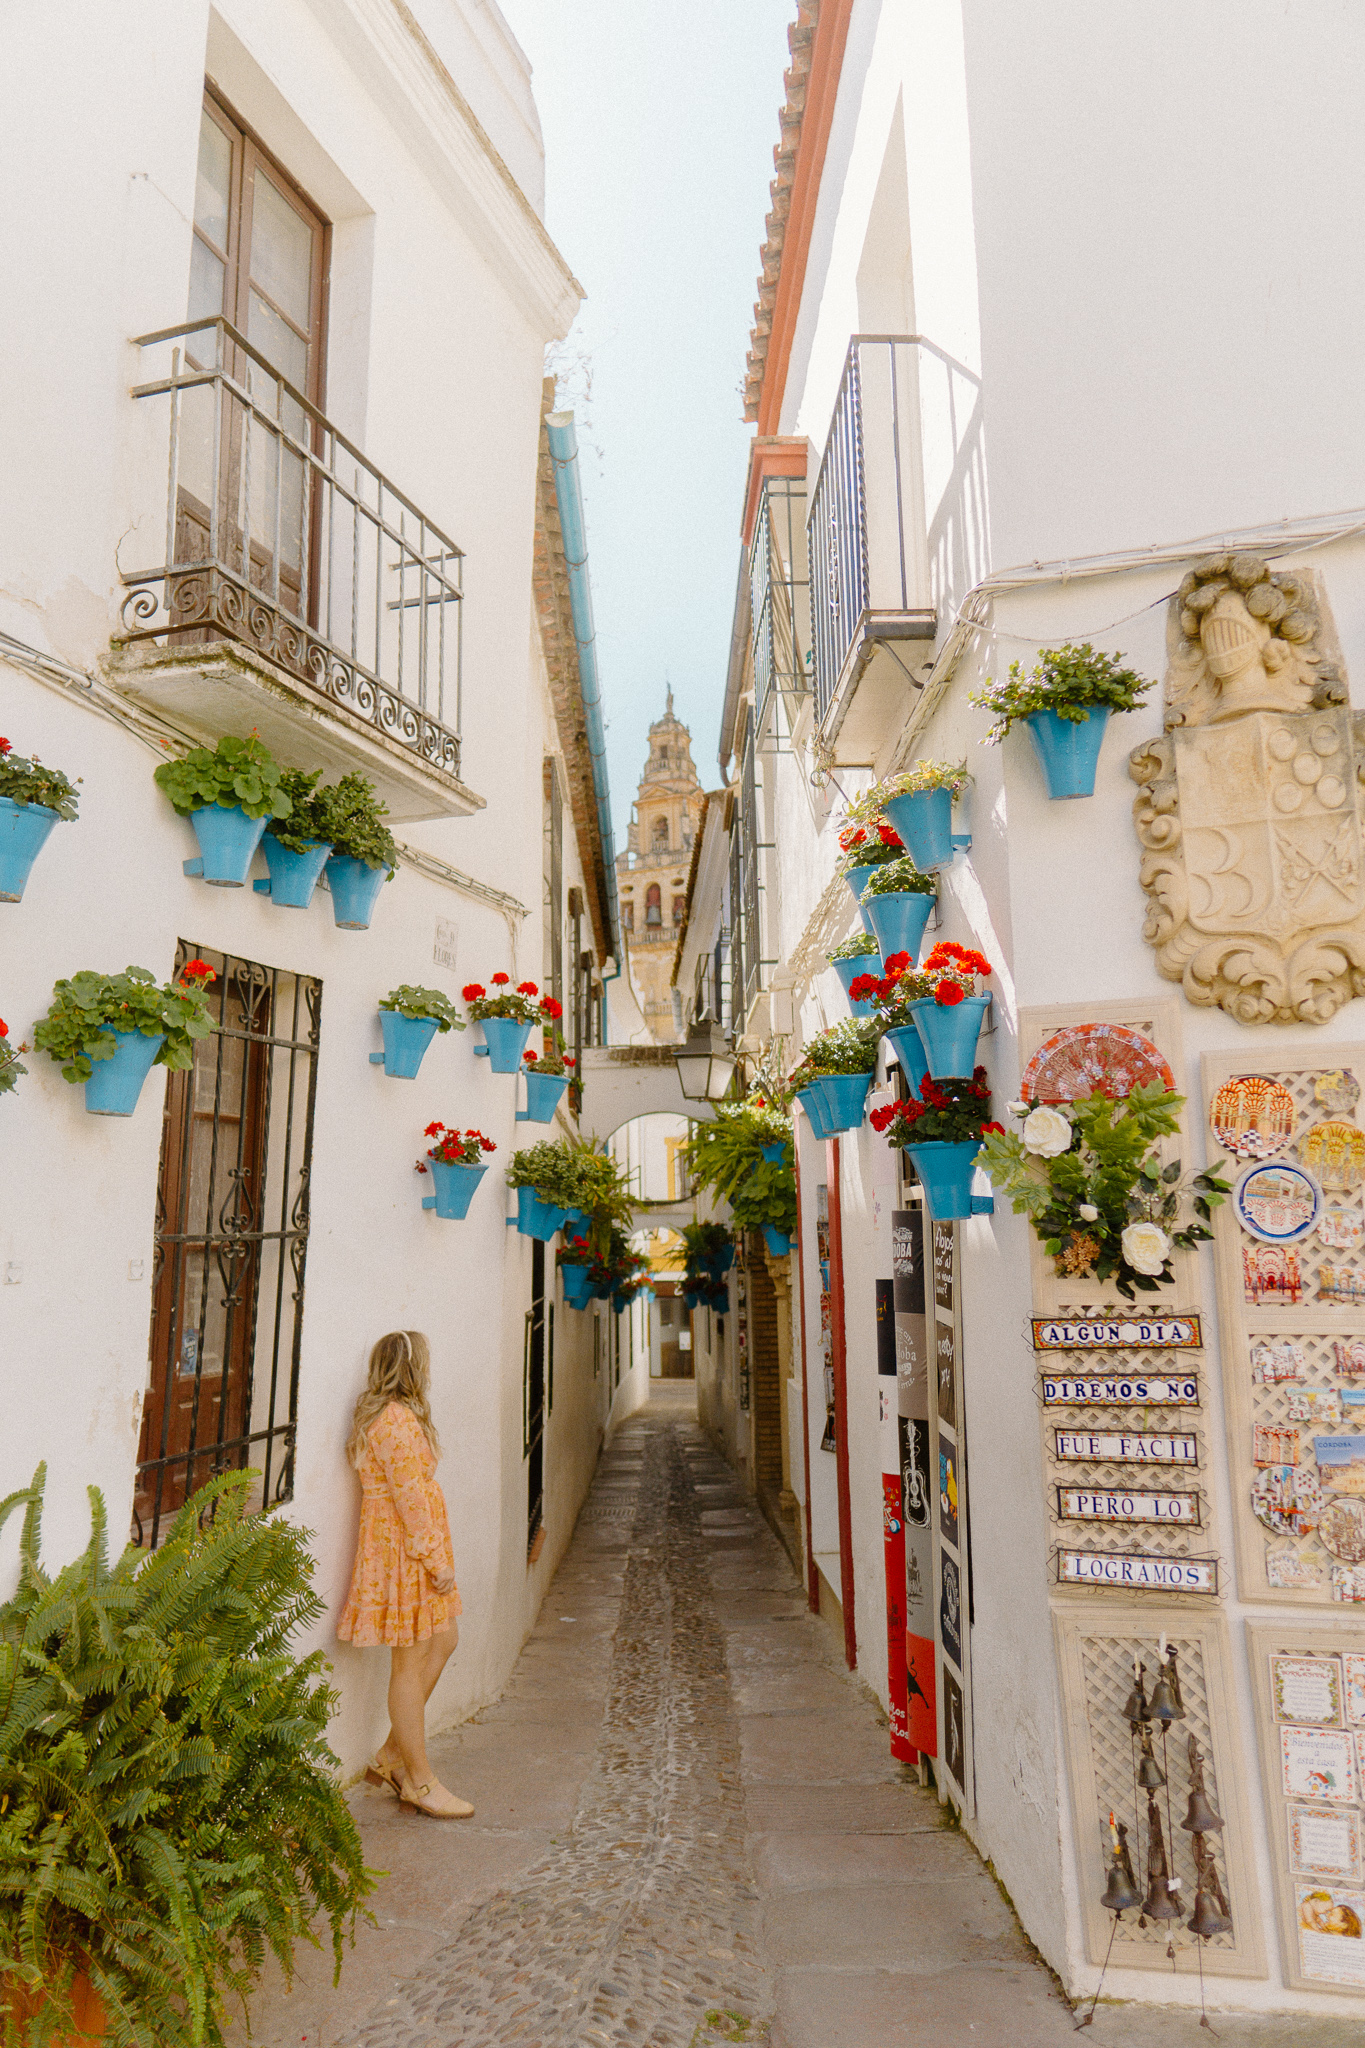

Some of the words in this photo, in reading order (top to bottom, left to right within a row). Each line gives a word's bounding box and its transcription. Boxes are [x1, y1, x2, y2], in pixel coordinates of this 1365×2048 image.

[1048, 1325, 1120, 1342] ALGUN
[1140, 1324, 1183, 1340] DIA
[1045, 1383, 1148, 1399] DIREMOS
[1167, 1382, 1195, 1398] NO
[1058, 1437, 1101, 1455] FUE
[1119, 1439, 1196, 1459] FACIL
[1076, 1495, 1135, 1515] PERO
[1154, 1499, 1182, 1518] LO
[1075, 1557, 1200, 1585] LOGRAMOS
